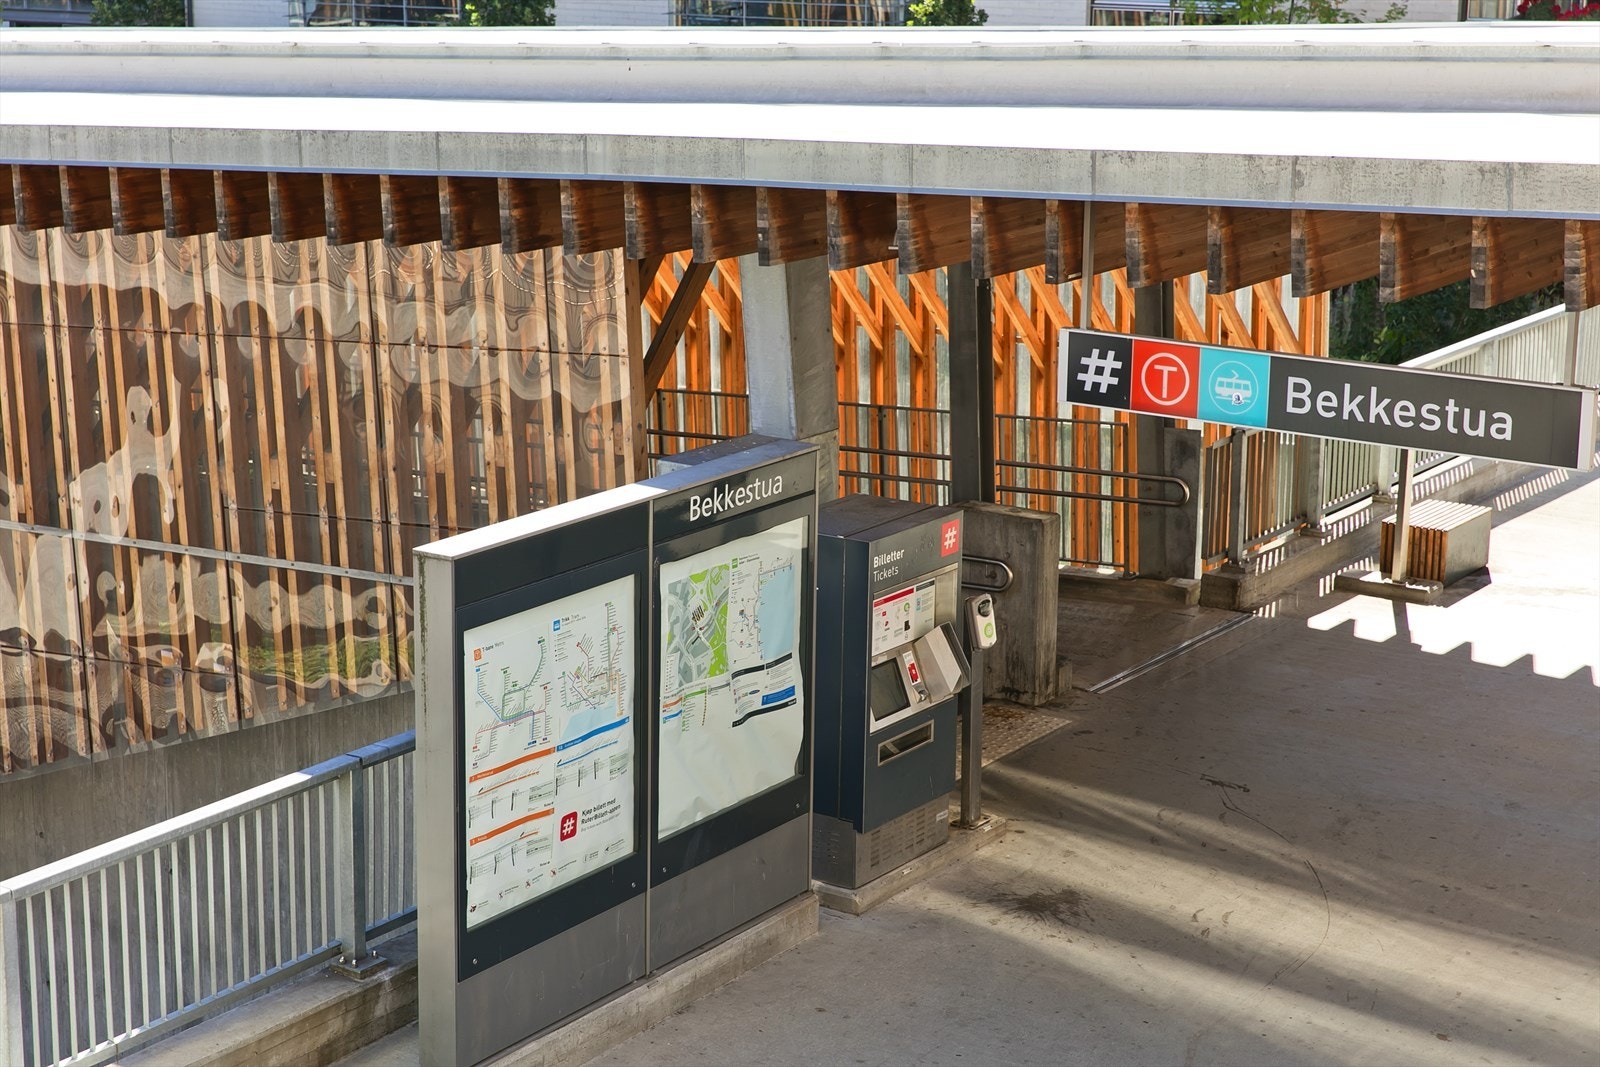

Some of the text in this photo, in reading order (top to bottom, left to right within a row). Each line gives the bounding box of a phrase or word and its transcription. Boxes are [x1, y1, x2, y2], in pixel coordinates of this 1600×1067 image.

[1285, 375, 1514, 442] Bekkestua
[689, 475, 783, 522] Bekkestua
[873, 549, 905, 568] Billetter
[873, 564, 899, 583] Tickets
[607, 797, 616, 807] med
